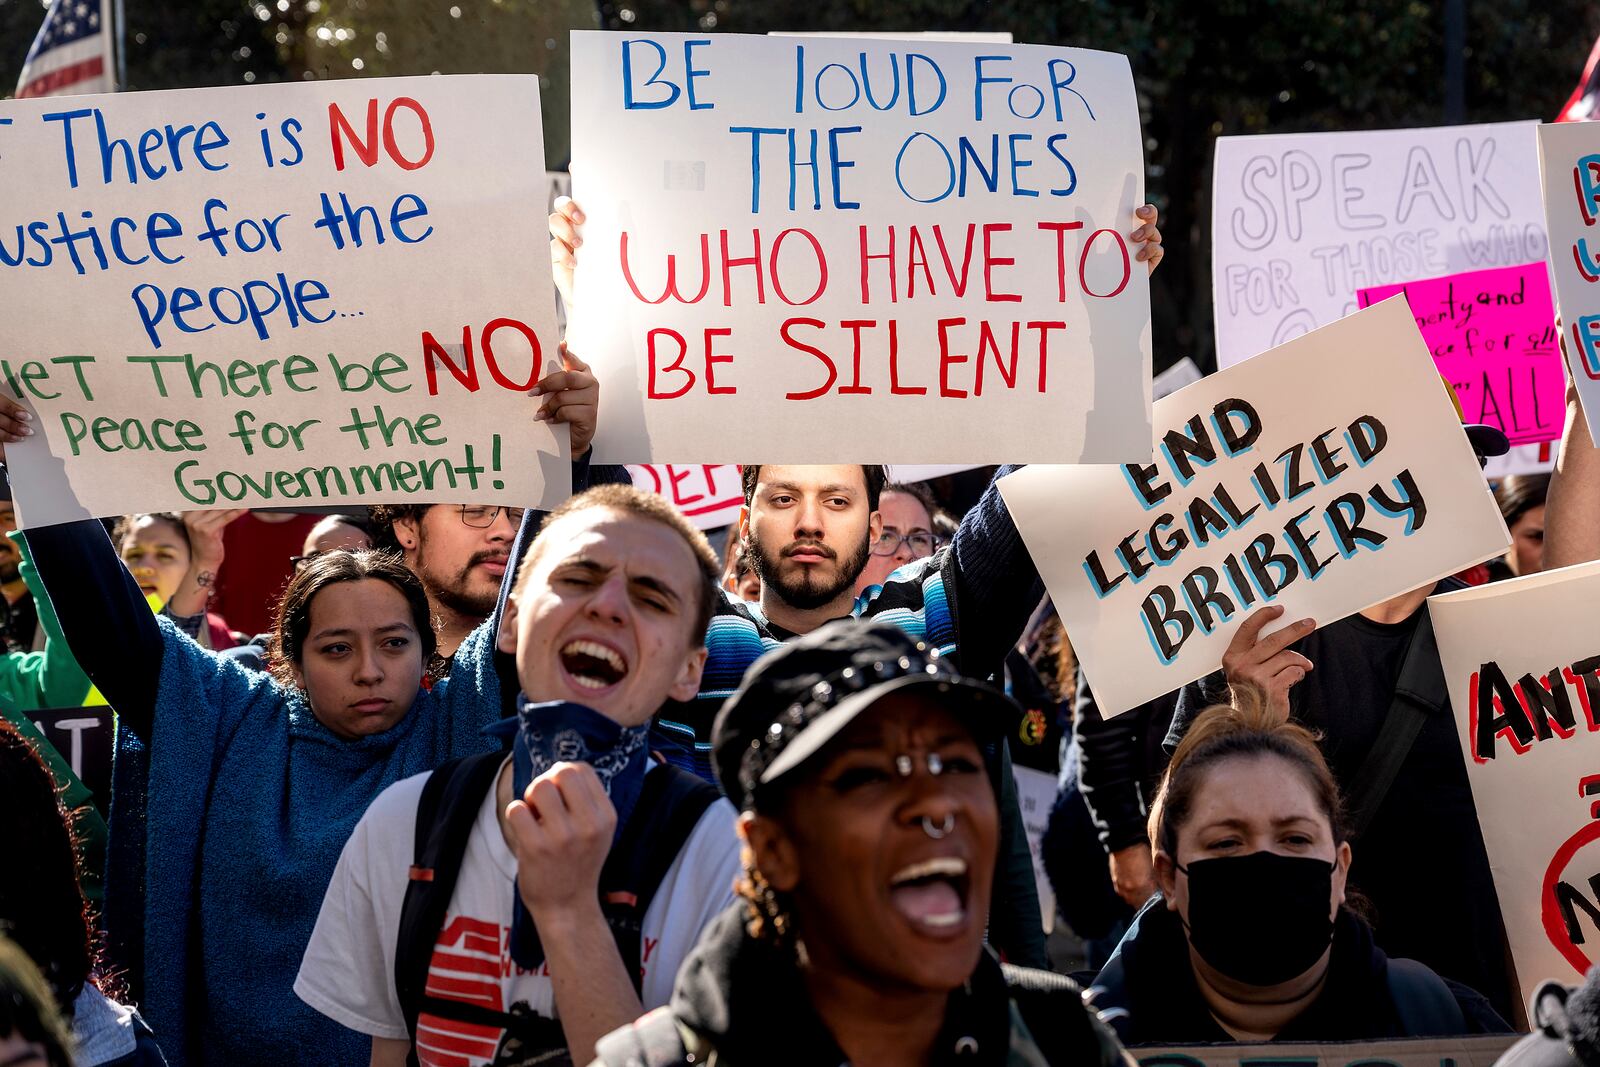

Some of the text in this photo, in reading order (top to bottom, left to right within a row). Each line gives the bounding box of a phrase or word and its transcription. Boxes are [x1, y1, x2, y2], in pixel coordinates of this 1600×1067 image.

[622, 40, 714, 110] BE
[43, 109, 229, 188] There
[256, 113, 303, 167] is
[329, 97, 435, 171] NO
[730, 127, 1076, 213] THE ONES
[0, 193, 433, 274] ustice for the
[1232, 137, 1510, 251] SPEAK
[620, 221, 1131, 306] WHO HAVE TO
[1225, 259, 1299, 317] FOR
[1312, 229, 1450, 298] THOSE
[1459, 223, 1548, 267] WHO
[1477, 276, 1524, 305] and
[128, 354, 317, 397] There
[328, 353, 412, 393] be
[422, 318, 542, 396] NO
[647, 318, 1066, 400] BE SILENT
[1465, 328, 1515, 356] for
[229, 410, 322, 455] for
[340, 406, 447, 450] the
[1480, 367, 1550, 432] ALL
[174, 434, 505, 505] Government!
[1120, 398, 1261, 510] END
[1083, 415, 1388, 599] LEGALIZED
[1141, 469, 1427, 666] BRIBERY
